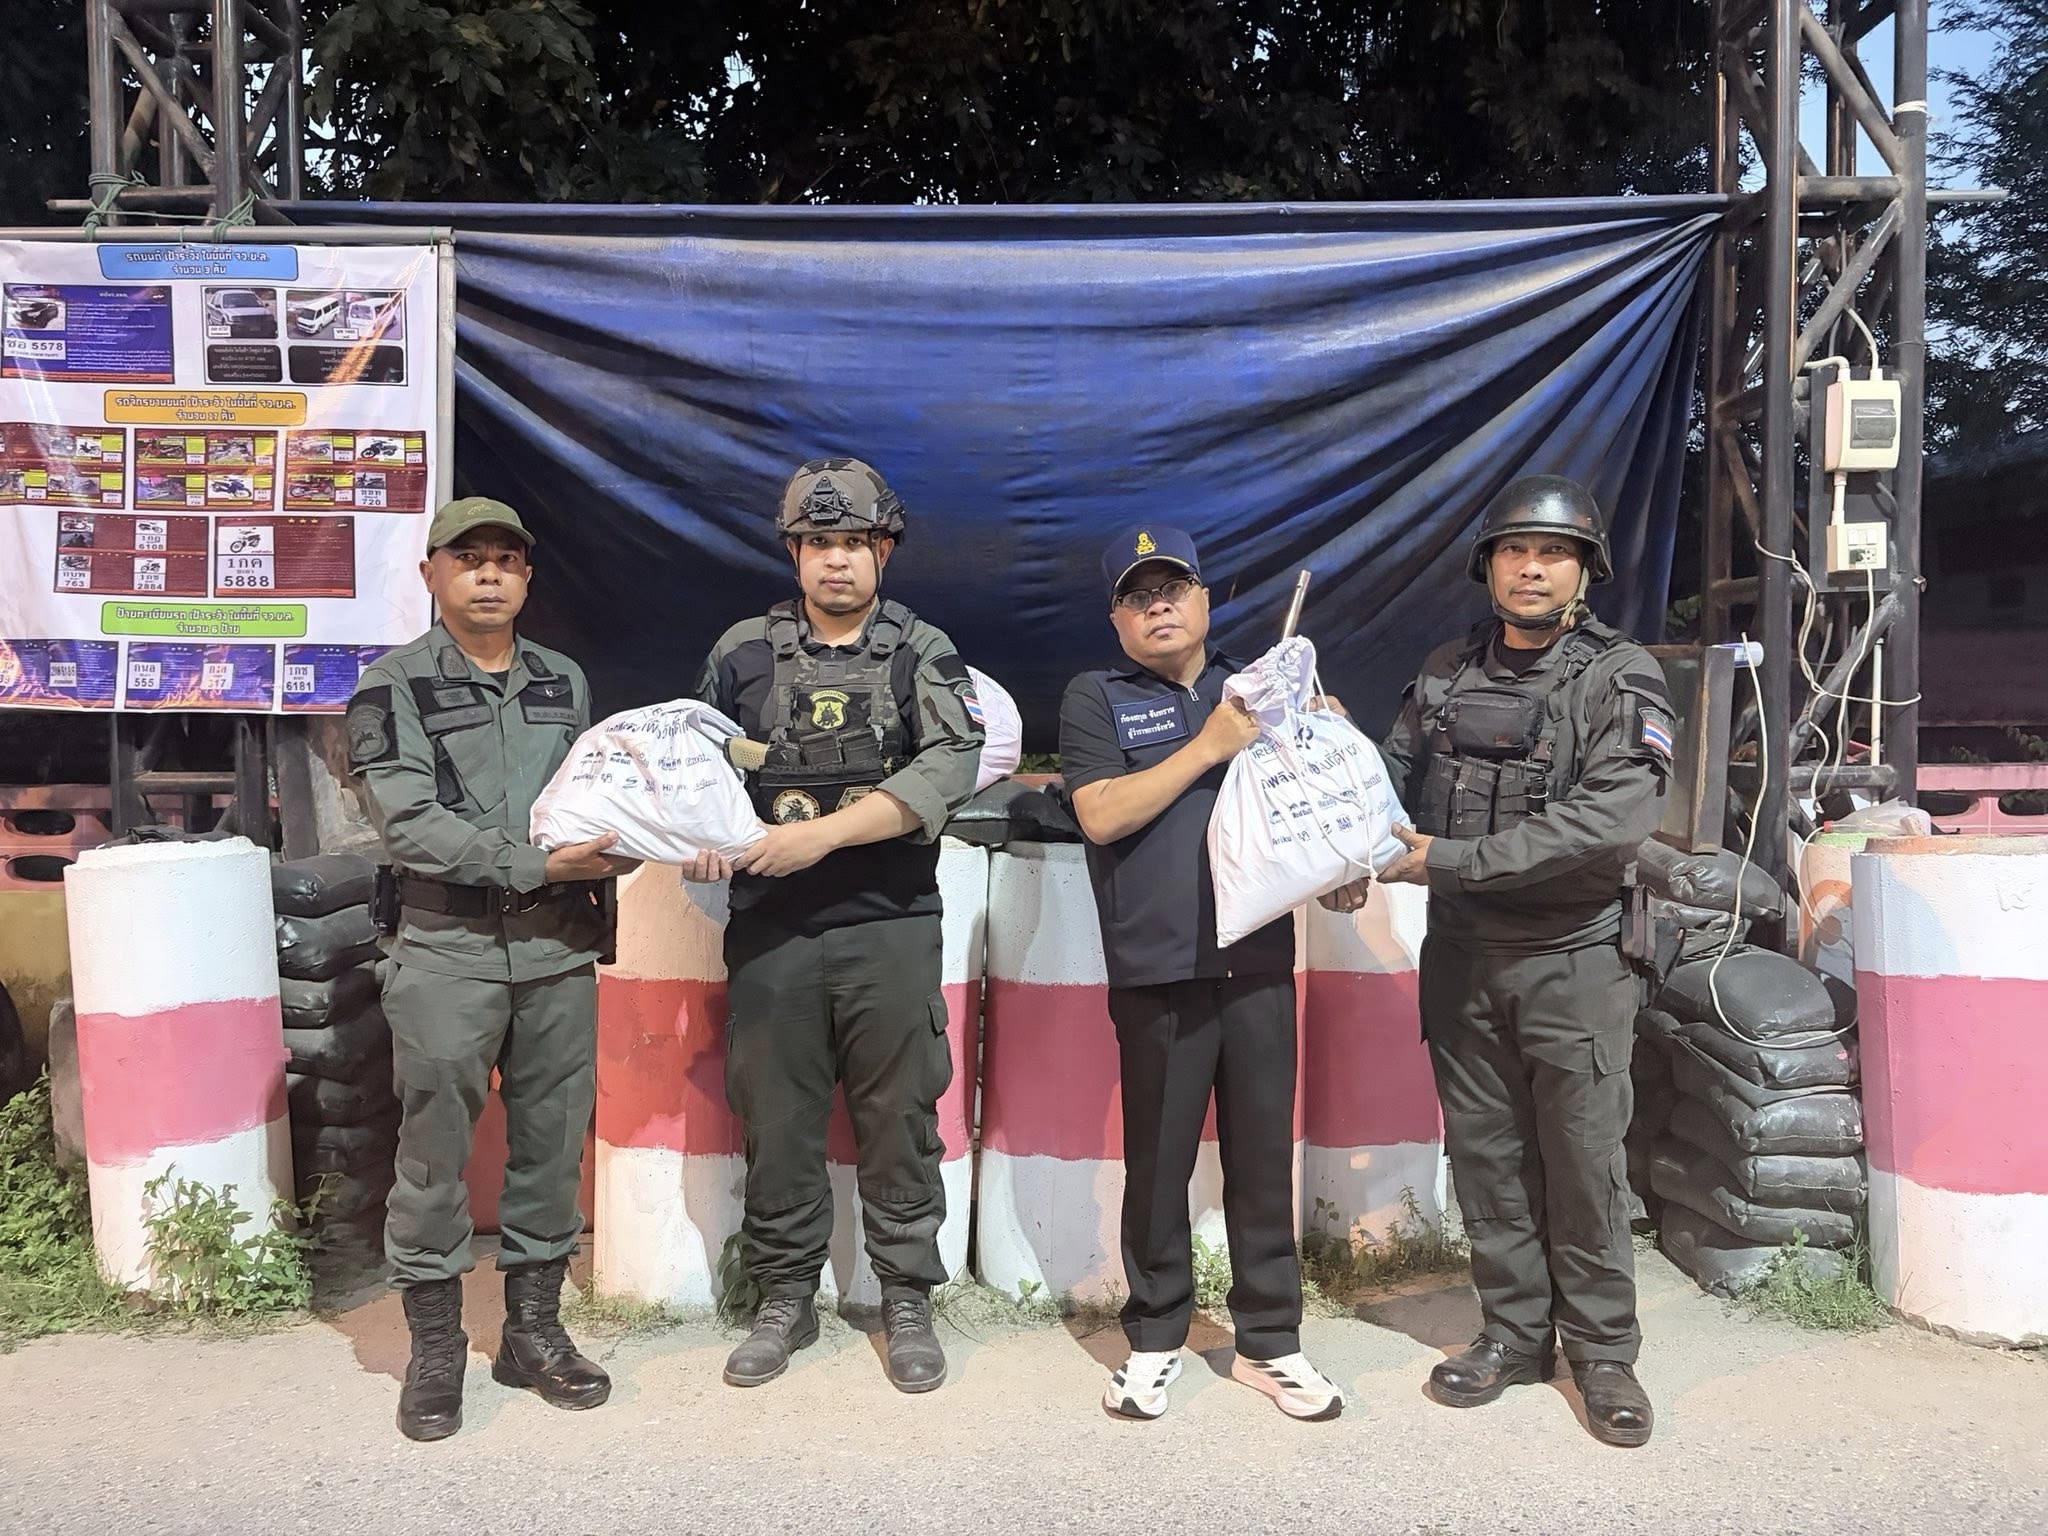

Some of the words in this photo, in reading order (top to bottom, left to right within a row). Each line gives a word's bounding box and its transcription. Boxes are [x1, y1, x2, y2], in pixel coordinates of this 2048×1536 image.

[31, 342, 63, 351] 5578
[361, 498, 381, 506] 720
[224, 575, 269, 587] 5888
[134, 678, 154, 687] 555
[286, 681, 311, 691] 6181
